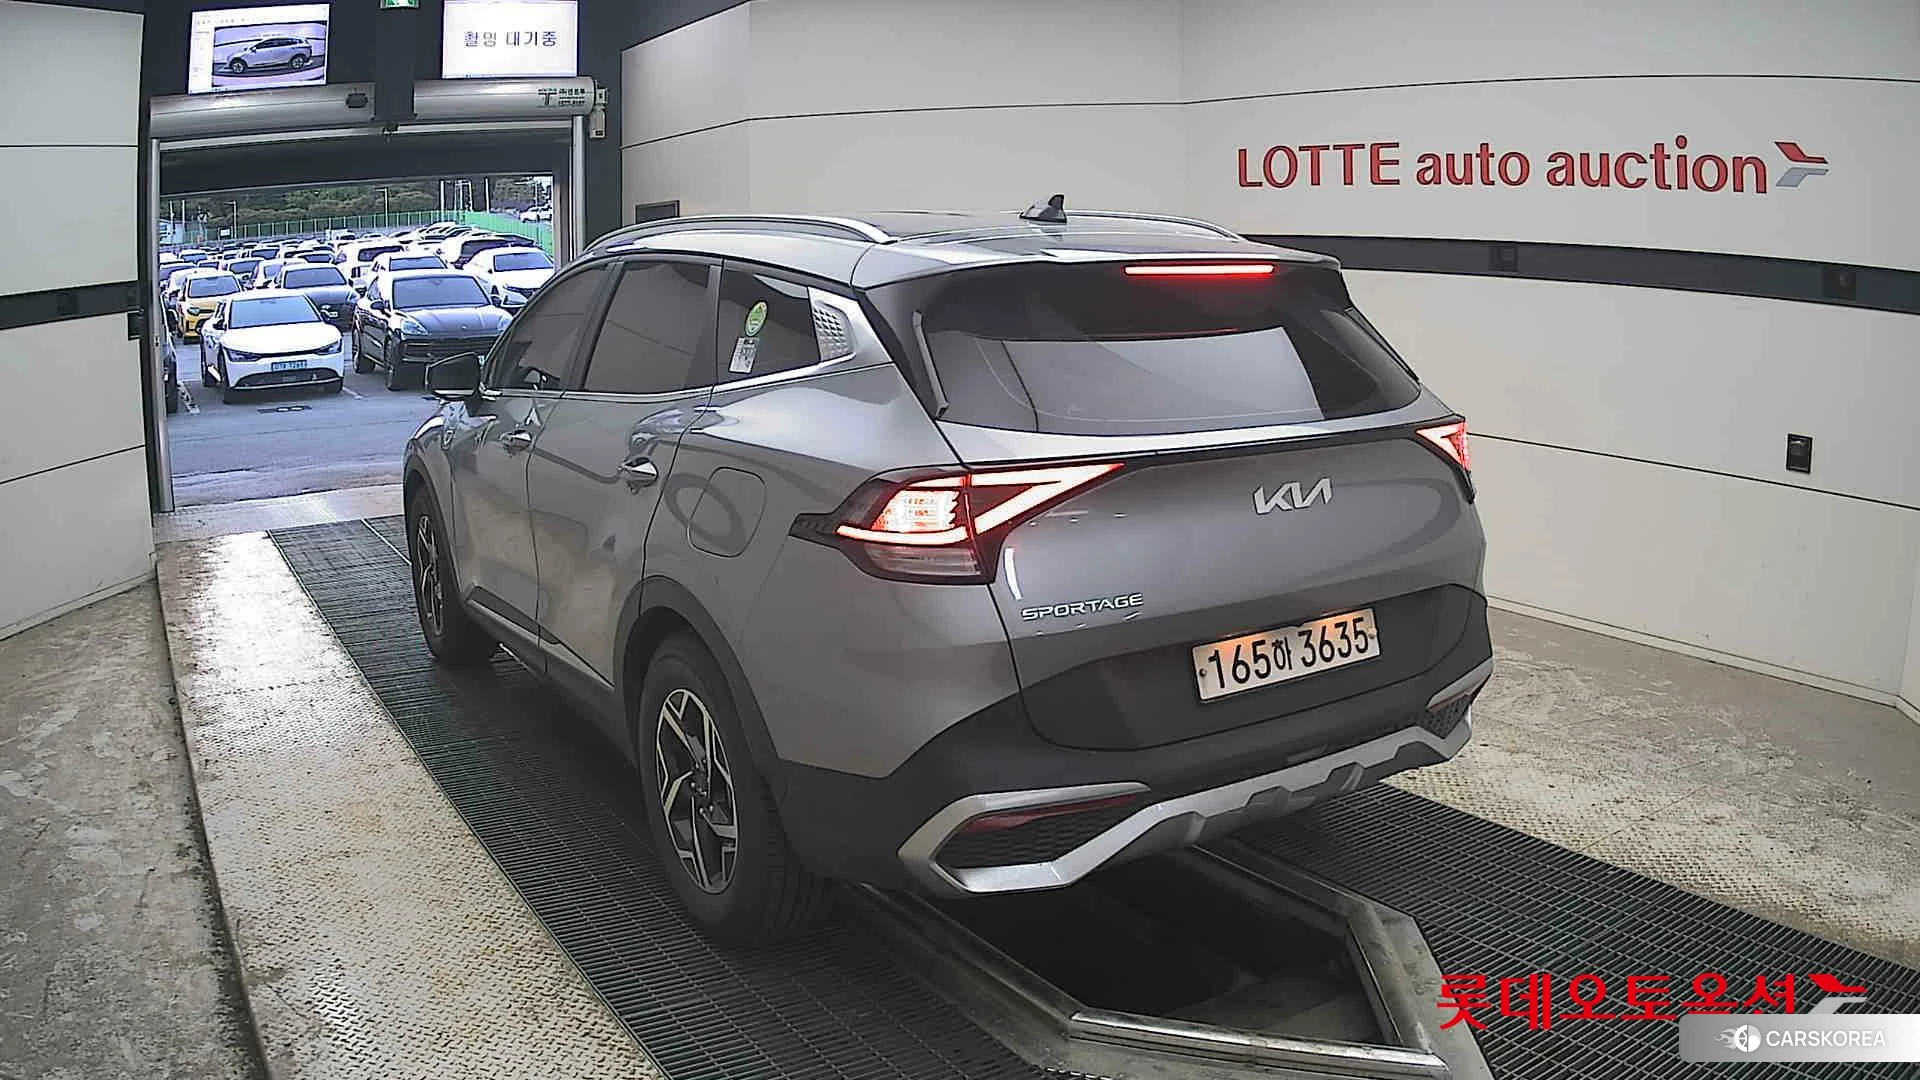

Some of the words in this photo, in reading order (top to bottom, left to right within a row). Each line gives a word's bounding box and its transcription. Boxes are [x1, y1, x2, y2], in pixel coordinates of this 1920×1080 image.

[505, 31, 557, 47] 대기중
[1237, 141, 1400, 189] LOTTE
[1416, 141, 1530, 187] auto
[1546, 135, 1768, 195] auction
[1253, 477, 1333, 515] KIA
[1021, 592, 1144, 621] SPORTAGE
[1208, 636, 1292, 689] 165하
[1298, 616, 1369, 668] 3635
